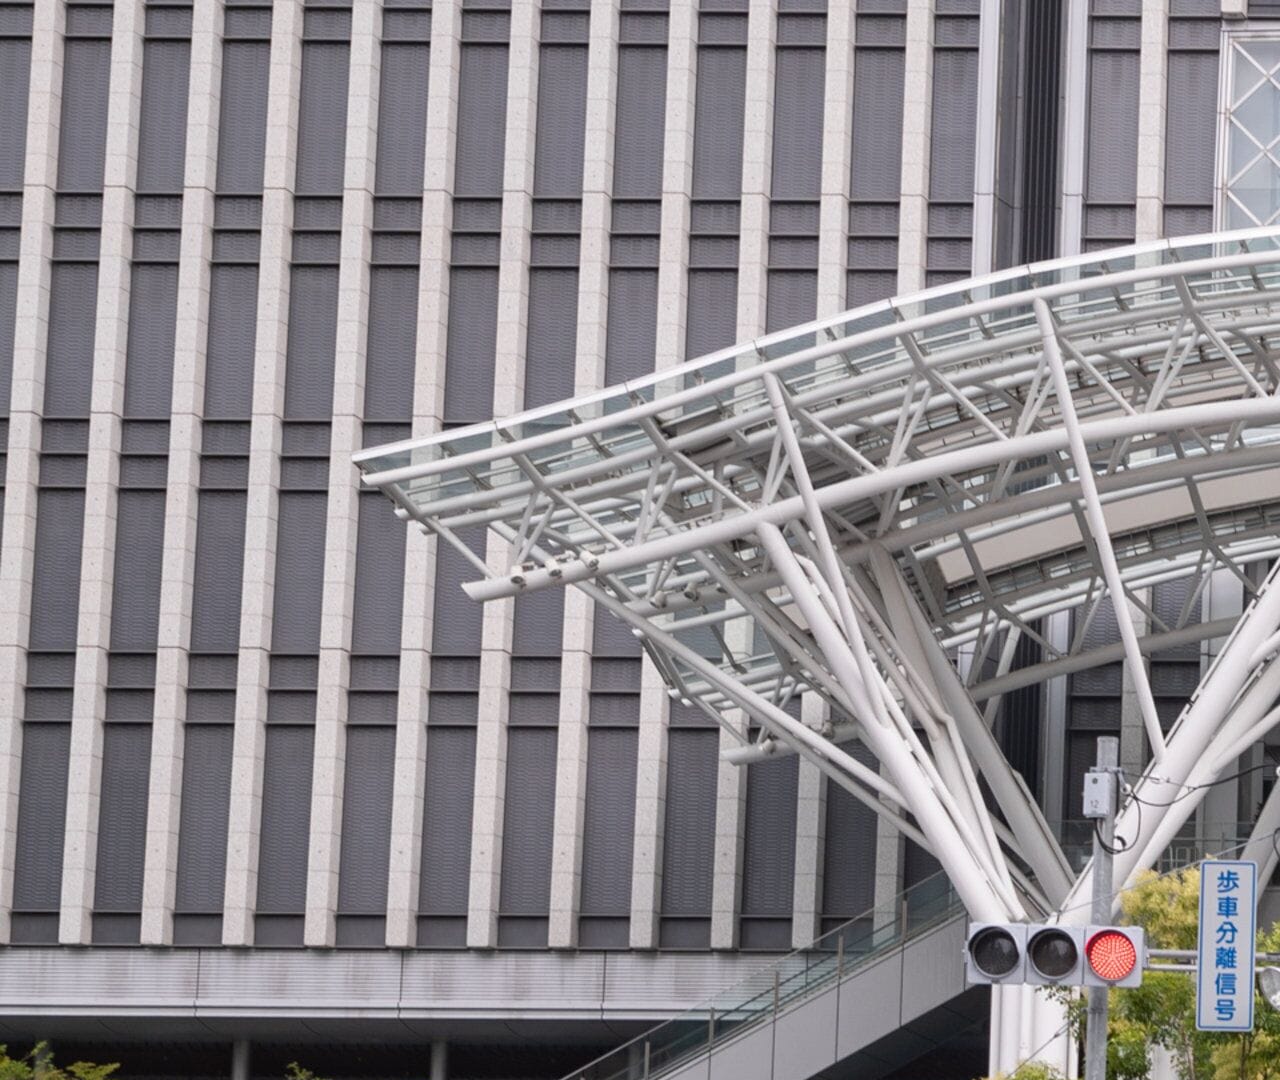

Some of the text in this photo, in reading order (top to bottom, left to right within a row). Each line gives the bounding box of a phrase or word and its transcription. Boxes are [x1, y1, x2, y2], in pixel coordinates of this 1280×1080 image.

[1214, 869, 1240, 1022] 歩車分離信号
